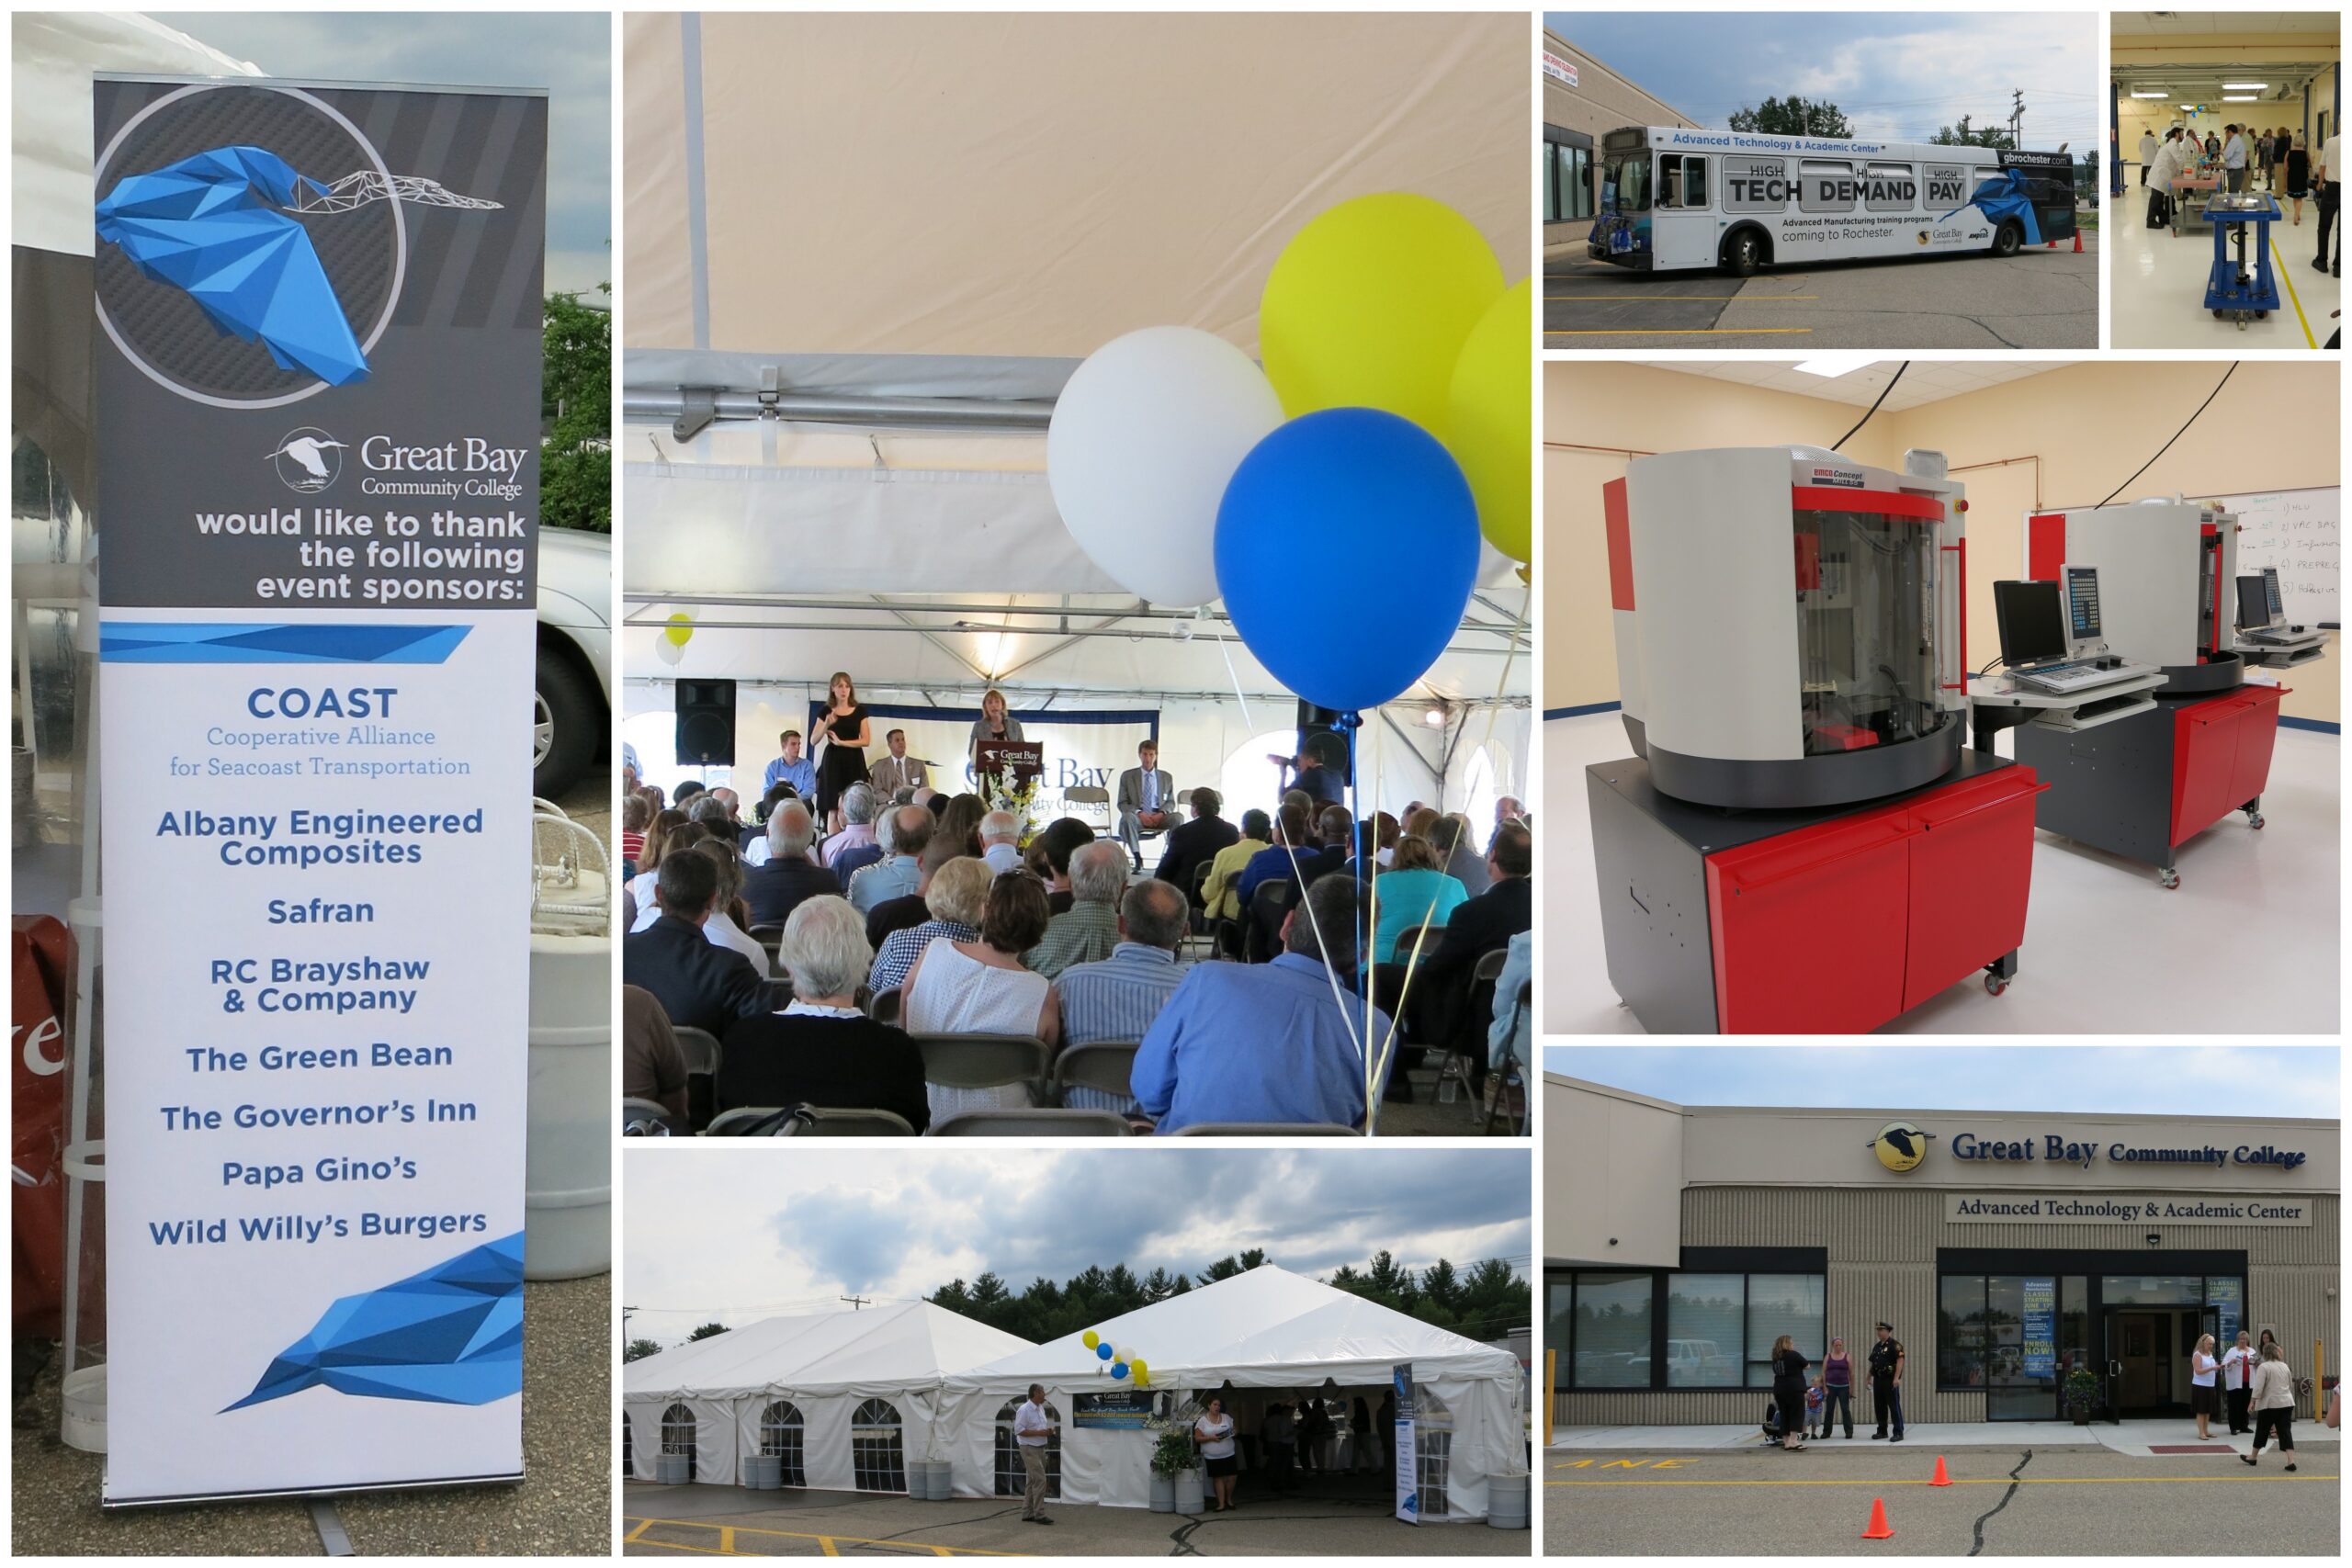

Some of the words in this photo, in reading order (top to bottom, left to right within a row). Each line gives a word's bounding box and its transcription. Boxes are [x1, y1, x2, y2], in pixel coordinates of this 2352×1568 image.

[1673, 134, 1730, 146] Advanced
[1734, 137, 1792, 150] Technology
[1795, 141, 1802, 149] &
[1804, 141, 1849, 152] Academic
[1851, 143, 1879, 153] Center
[1750, 165, 1784, 176] HIGH
[1934, 170, 1957, 180] HIGH
[2004, 153, 2067, 166] gbrochester.com
[1729, 179, 1803, 202] TECH
[1820, 181, 1917, 201] DEMAND
[1929, 182, 1962, 200] PAY
[1782, 218, 1822, 227] Advanced
[1825, 217, 1875, 227] Manufacturing
[1877, 216, 1903, 225] training
[1904, 215, 1933, 224] programs
[1933, 229, 1951, 238] Great
[1951, 229, 1963, 238] Bay
[1782, 231, 1825, 242] coming
[1828, 231, 1839, 240] to
[1843, 229, 1894, 240] Rochester.
[362, 436, 458, 471] Great
[463, 438, 527, 484] Bay
[1814, 468, 1833, 477] emco
[1834, 469, 1862, 480] Concept
[362, 478, 461, 500] Community
[465, 479, 522, 501] College
[196, 508, 300, 535] would
[315, 509, 373, 536] like
[385, 512, 419, 536] to
[432, 511, 526, 536] thank
[2292, 520, 2312, 530] VAC
[300, 540, 355, 567] the
[367, 541, 524, 573] following
[257, 574, 351, 598] event
[363, 579, 523, 604] sponsors:
[248, 688, 398, 718] COAST
[208, 728, 339, 750] Cooperative
[347, 726, 435, 744] Alliance
[171, 757, 200, 775] for
[209, 758, 301, 775] Seacoast
[310, 757, 469, 779] Transportation
[1001, 750, 1023, 760] Great
[1024, 751, 1039, 761] Bay
[1057, 758, 1114, 789] Bay
[156, 810, 277, 841] Albany
[291, 808, 482, 840] Engineered
[220, 840, 422, 870] Composites
[268, 897, 373, 924] Safran
[212, 959, 257, 984] RC
[272, 956, 430, 987] Brayshaw
[223, 989, 244, 1013] &
[258, 987, 417, 1015] Company
[186, 1047, 247, 1072] The
[259, 1046, 357, 1070] Green
[372, 1043, 452, 1066] Bean
[160, 1106, 221, 1131] The
[234, 1100, 415, 1128] Governor's
[428, 1100, 476, 1122] Inn
[1951, 1133, 2035, 1161] Great
[2044, 1135, 2099, 1169] Bay
[2109, 1144, 2228, 1168] Community
[2233, 1145, 2306, 1170] College
[223, 1162, 303, 1190] Papa
[316, 1156, 416, 1181] Gino's
[1957, 1200, 2040, 1216] Advanced
[2045, 1201, 2141, 1221] Technology
[2146, 1202, 2159, 1217] &
[2164, 1201, 2243, 1218] Academic
[2247, 1203, 2301, 1219] Center
[149, 1219, 226, 1246] Wild
[239, 1214, 348, 1244] Willy's
[361, 1213, 486, 1238] Burgers
